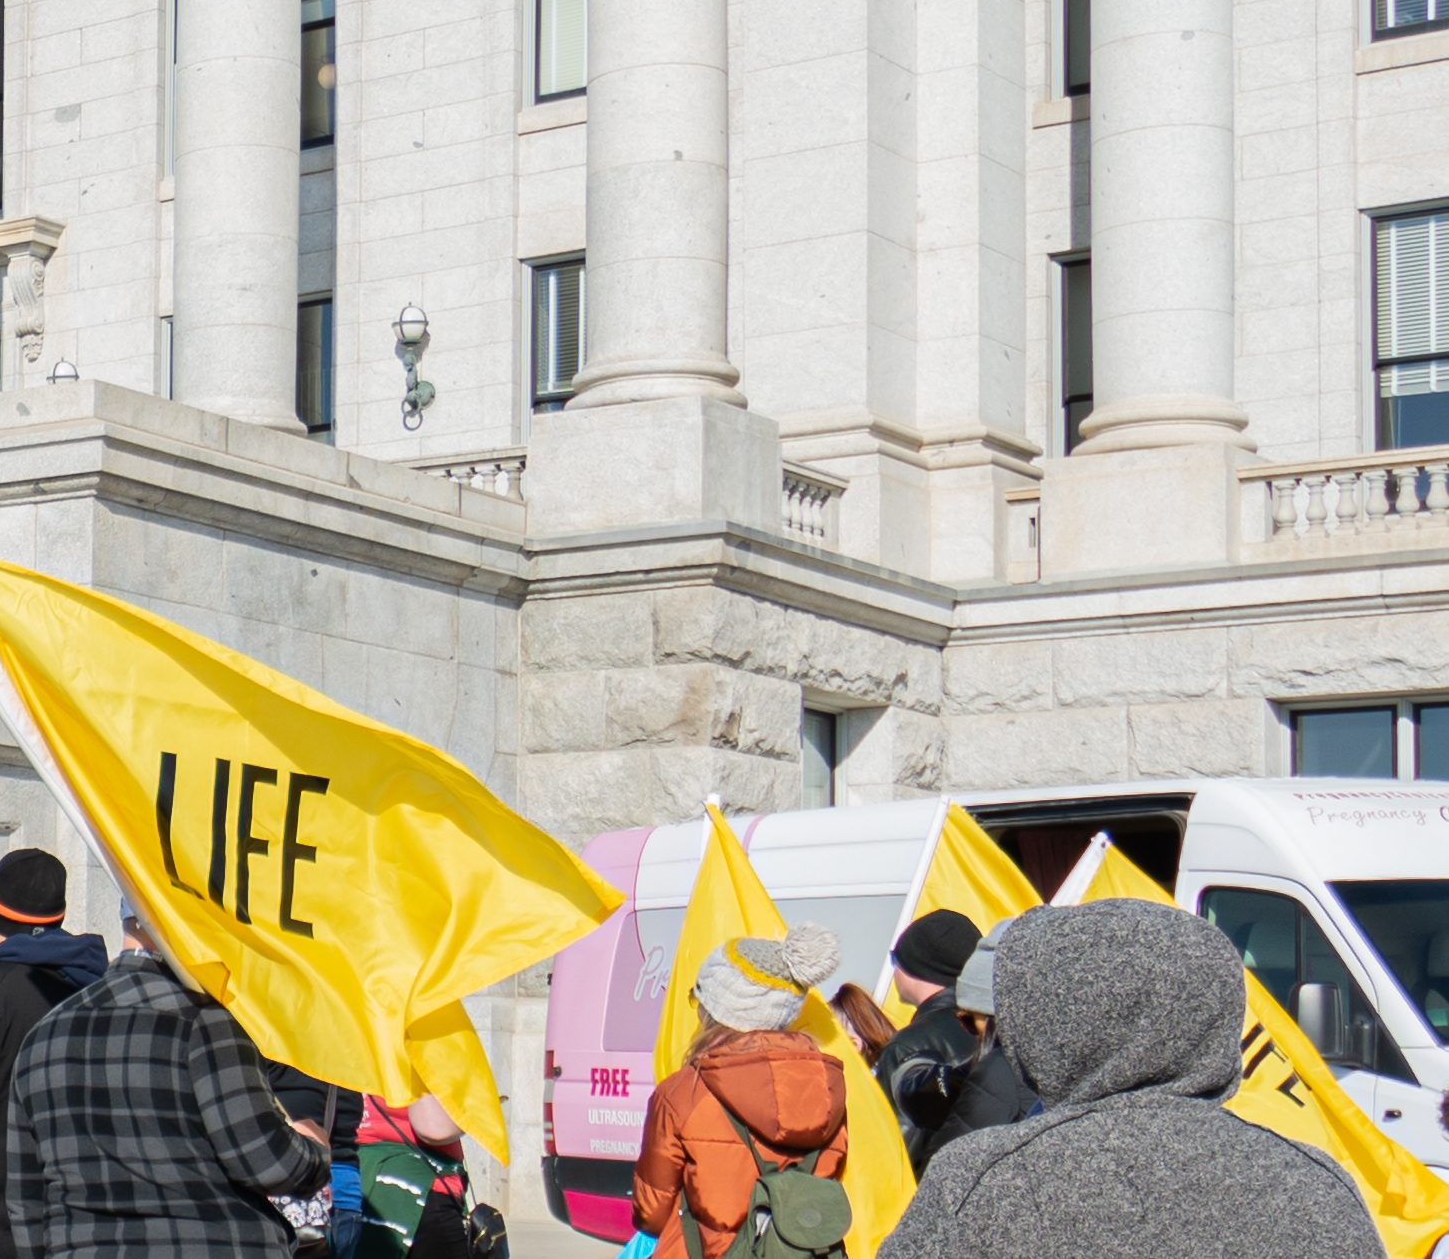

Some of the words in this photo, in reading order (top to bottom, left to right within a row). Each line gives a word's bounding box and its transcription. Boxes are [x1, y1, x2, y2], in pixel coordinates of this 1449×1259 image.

[1306, 806, 1427, 827] Pregnancy
[156, 751, 330, 940] LIFE
[590, 1067, 630, 1098] FREE
[588, 1108, 645, 1127] ULTRASOUN
